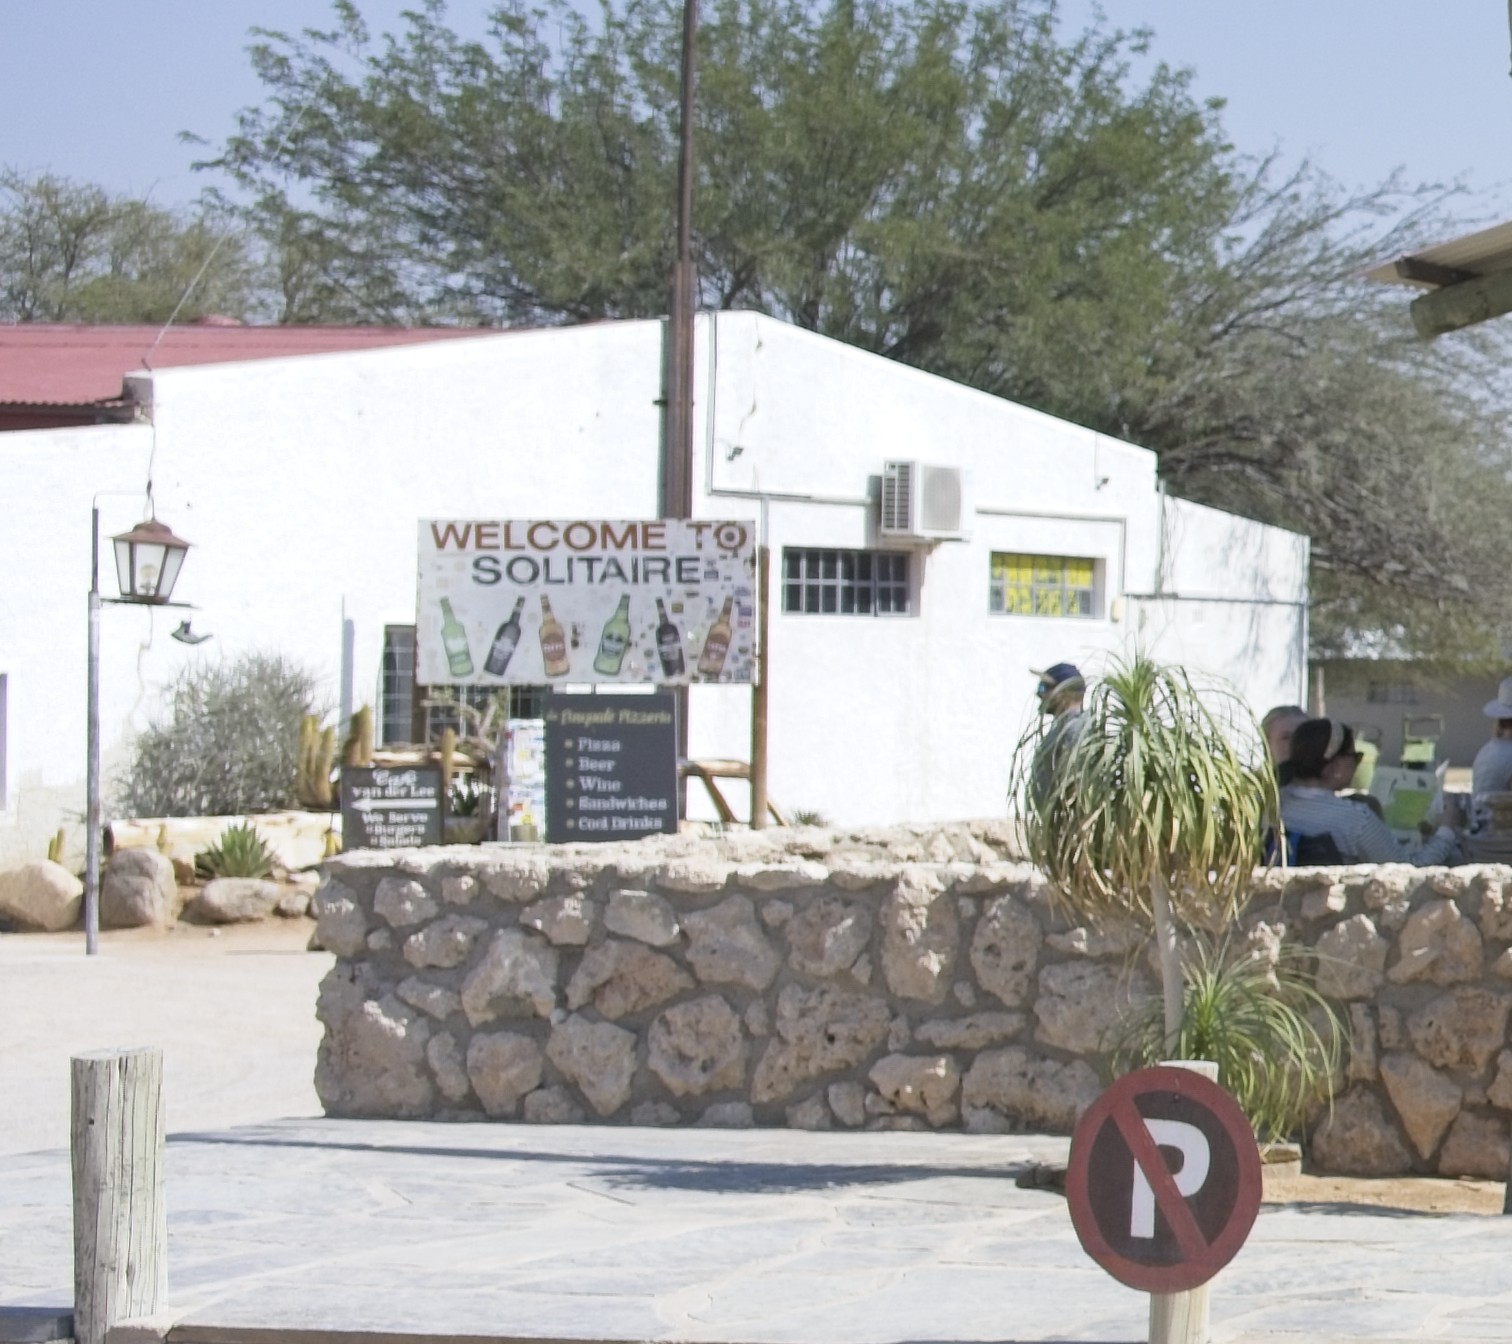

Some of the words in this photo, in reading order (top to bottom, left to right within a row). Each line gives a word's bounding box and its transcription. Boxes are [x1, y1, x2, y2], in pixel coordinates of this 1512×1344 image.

[431, 522, 667, 550] WELCOME
[686, 523, 748, 551] TO
[472, 556, 701, 586] SOLITAIRE
[618, 709, 672, 724] Pizzeria
[577, 736, 621, 752] Pizza
[578, 756, 616, 772] Beer
[352, 786, 382, 798] van
[384, 785, 407, 798] der
[410, 784, 435, 798] Lee
[578, 775, 622, 792] Wine
[578, 795, 668, 811] Sandwiches
[361, 812, 383, 824] We
[388, 811, 428, 824] Serve
[577, 816, 608, 831] Cool
[611, 815, 663, 830] Drinks
[1130, 1117, 1211, 1240] P
